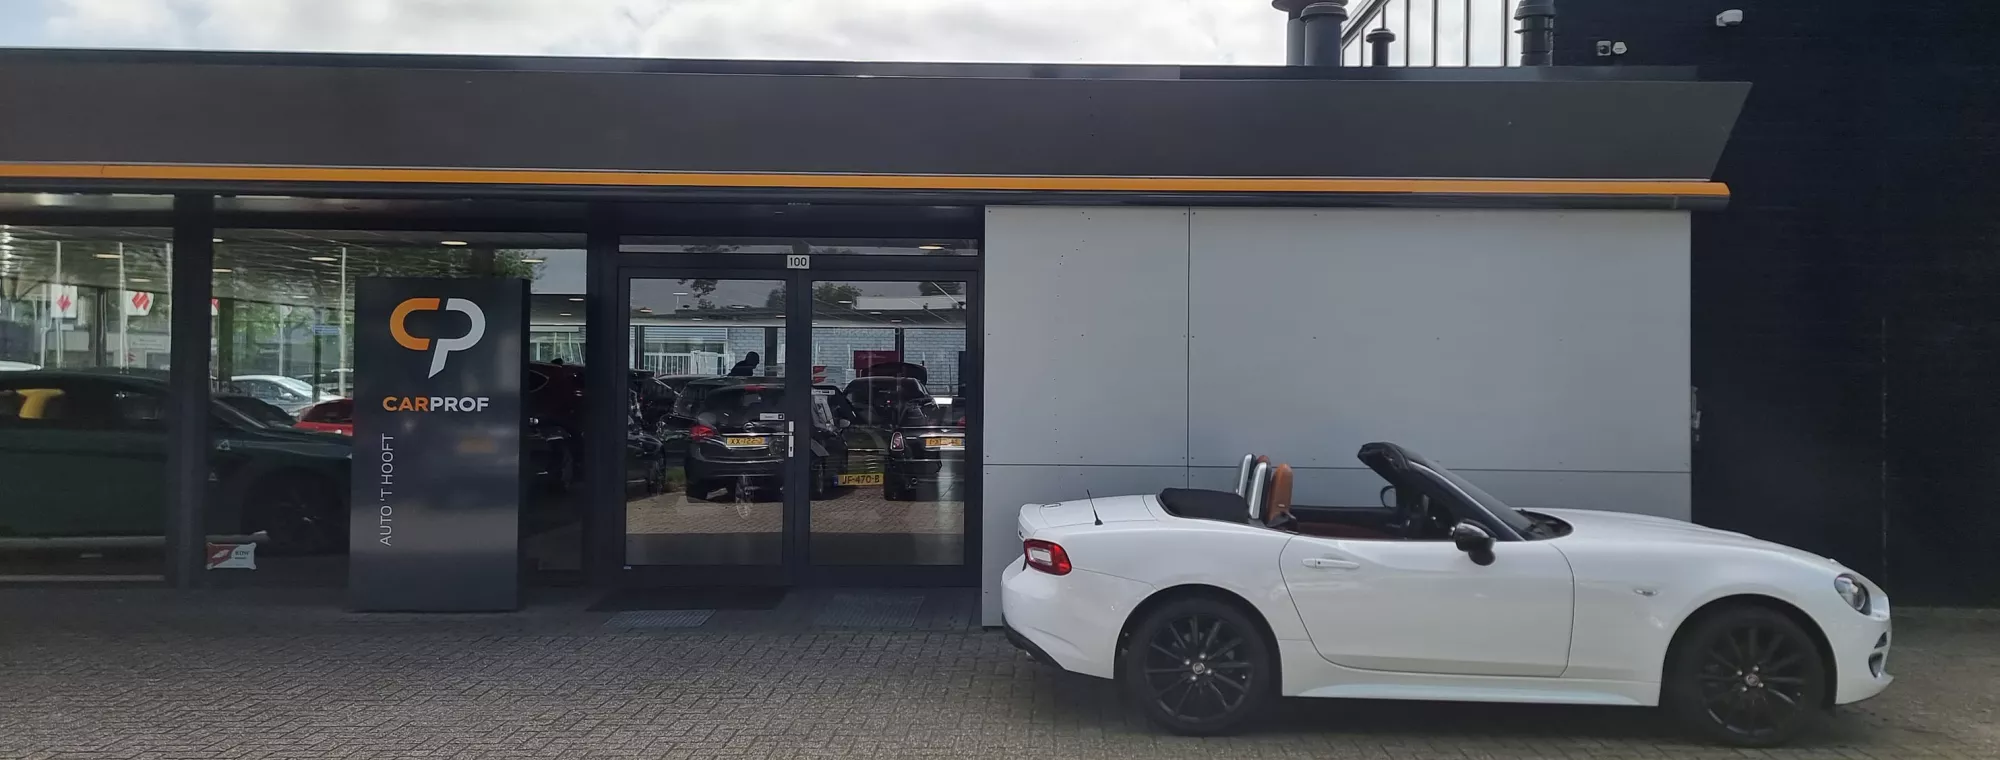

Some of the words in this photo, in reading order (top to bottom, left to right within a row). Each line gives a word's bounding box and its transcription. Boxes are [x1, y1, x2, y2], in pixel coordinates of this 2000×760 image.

[790, 257, 807, 267] 100
[382, 396, 490, 412] CARPROF
[381, 433, 395, 485] HOOFT
[380, 505, 393, 547] AUTO
